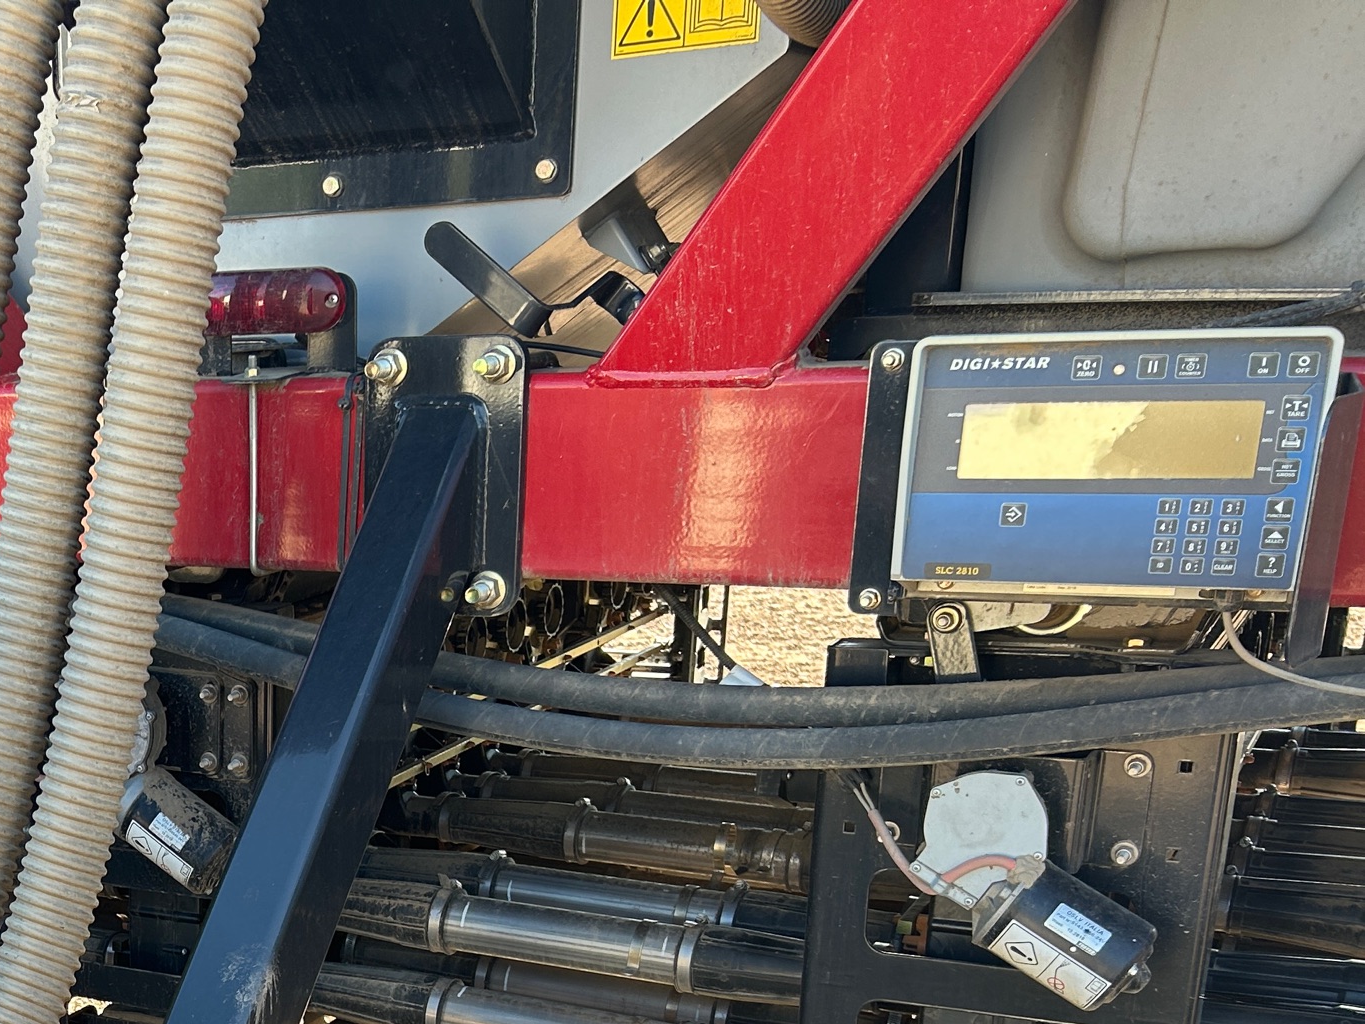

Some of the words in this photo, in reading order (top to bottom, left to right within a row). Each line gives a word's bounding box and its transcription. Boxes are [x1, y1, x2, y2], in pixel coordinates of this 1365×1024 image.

[1075, 370, 1096, 378] ZERO
[1292, 400, 1303, 412] T
[1164, 503, 1170, 512] 1
[1194, 503, 1201, 513] 2
[1226, 503, 1233, 513] 3
[1159, 522, 1166, 531] 4
[1191, 523, 1198, 532] 5
[1223, 523, 1230, 533] 6
[1156, 542, 1164, 551] 7
[1188, 542, 1195, 552] 8
[1220, 541, 1227, 551] 9
[935, 566, 954, 575] SLC
[956, 566, 979, 576] 2810
[1084, 921, 1105, 936] ITALIA
